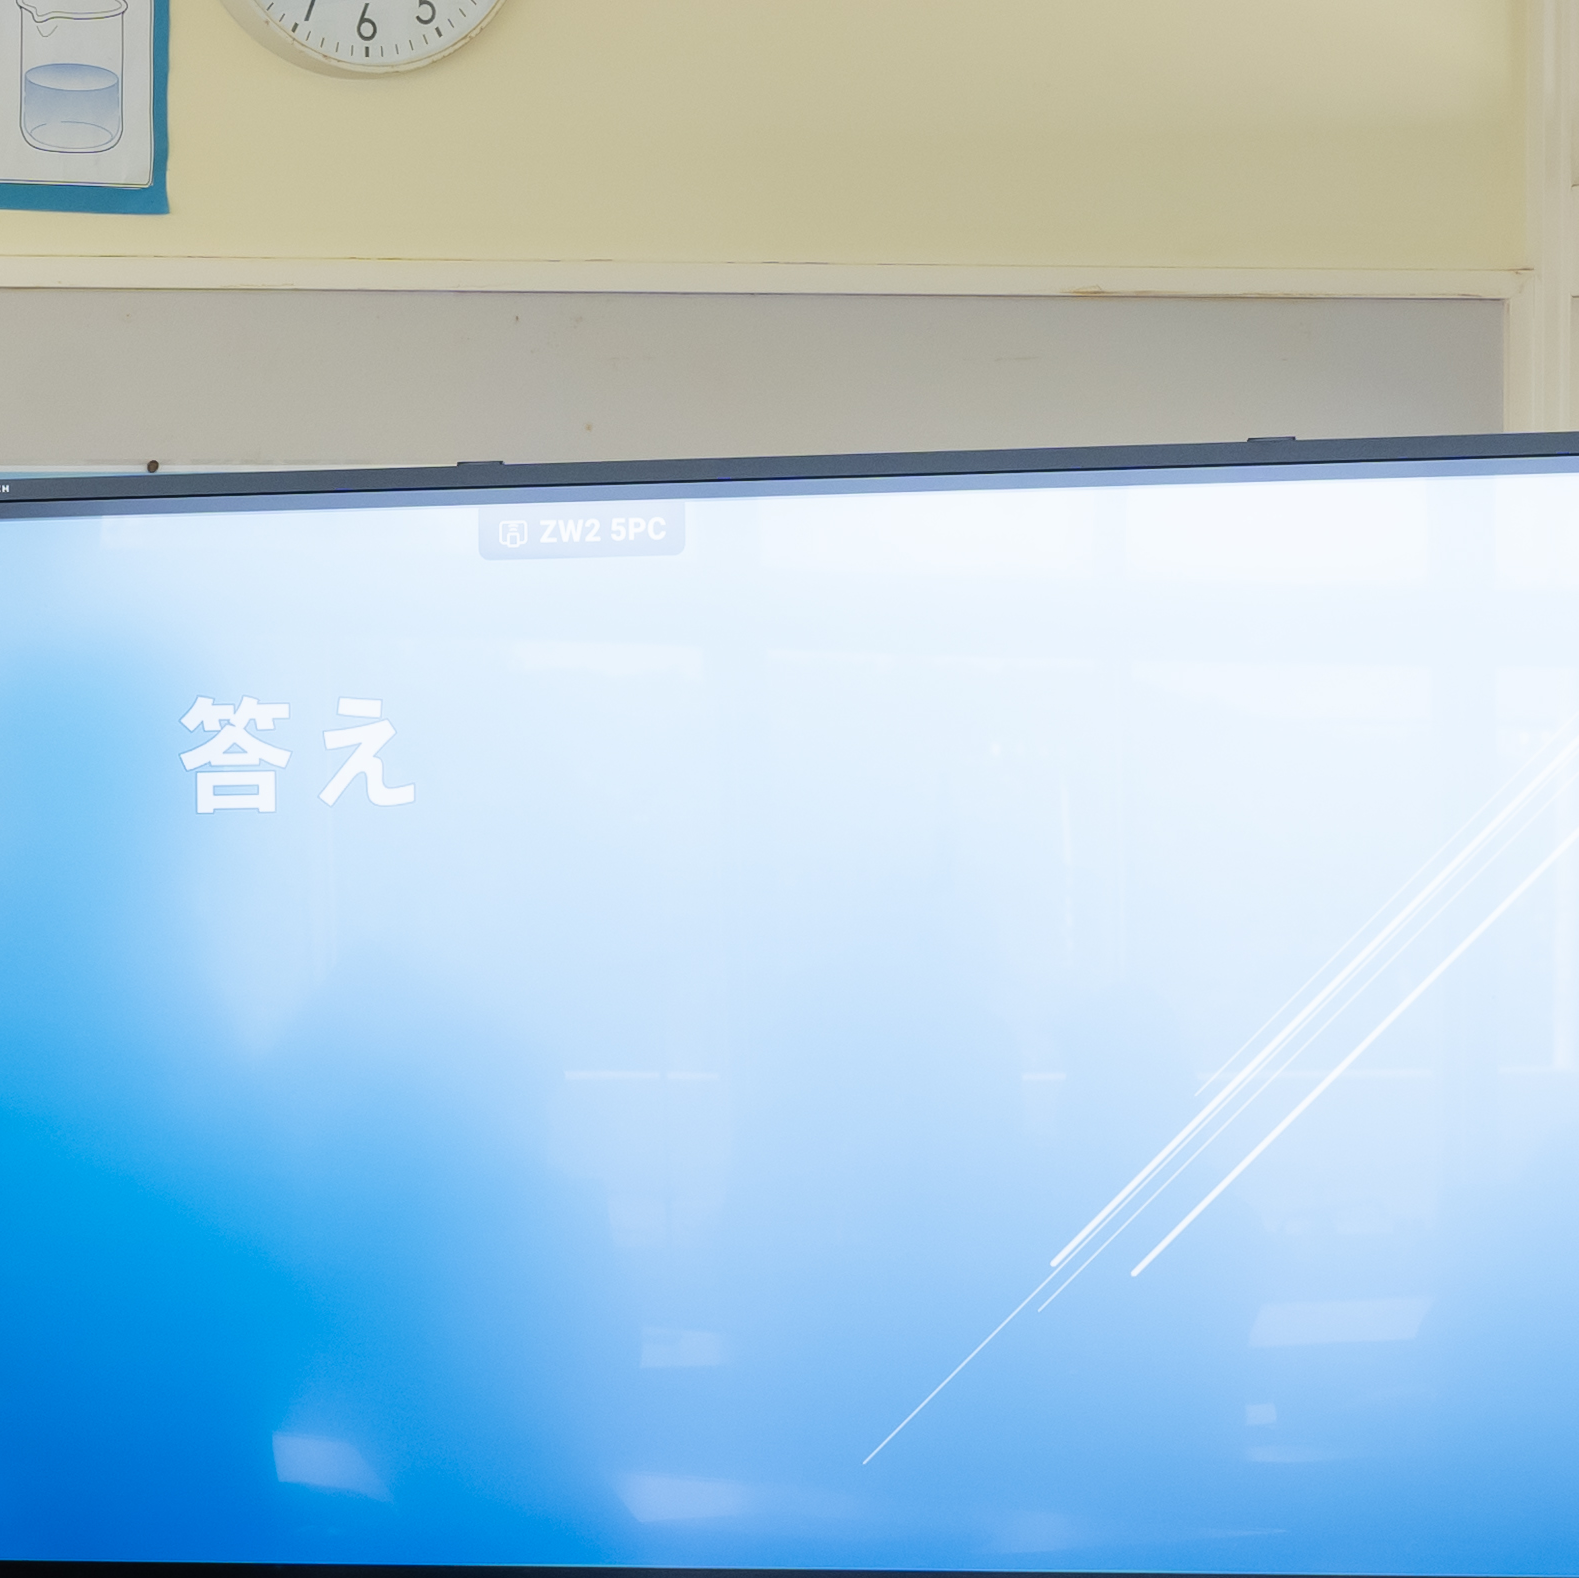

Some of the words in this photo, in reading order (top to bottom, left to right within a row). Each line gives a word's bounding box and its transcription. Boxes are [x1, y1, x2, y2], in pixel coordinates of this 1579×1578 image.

[356, 3, 378, 42] 6
[540, 517, 602, 543] ZW2
[611, 516, 666, 542] 5PC
[179, 695, 417, 815] 答え
